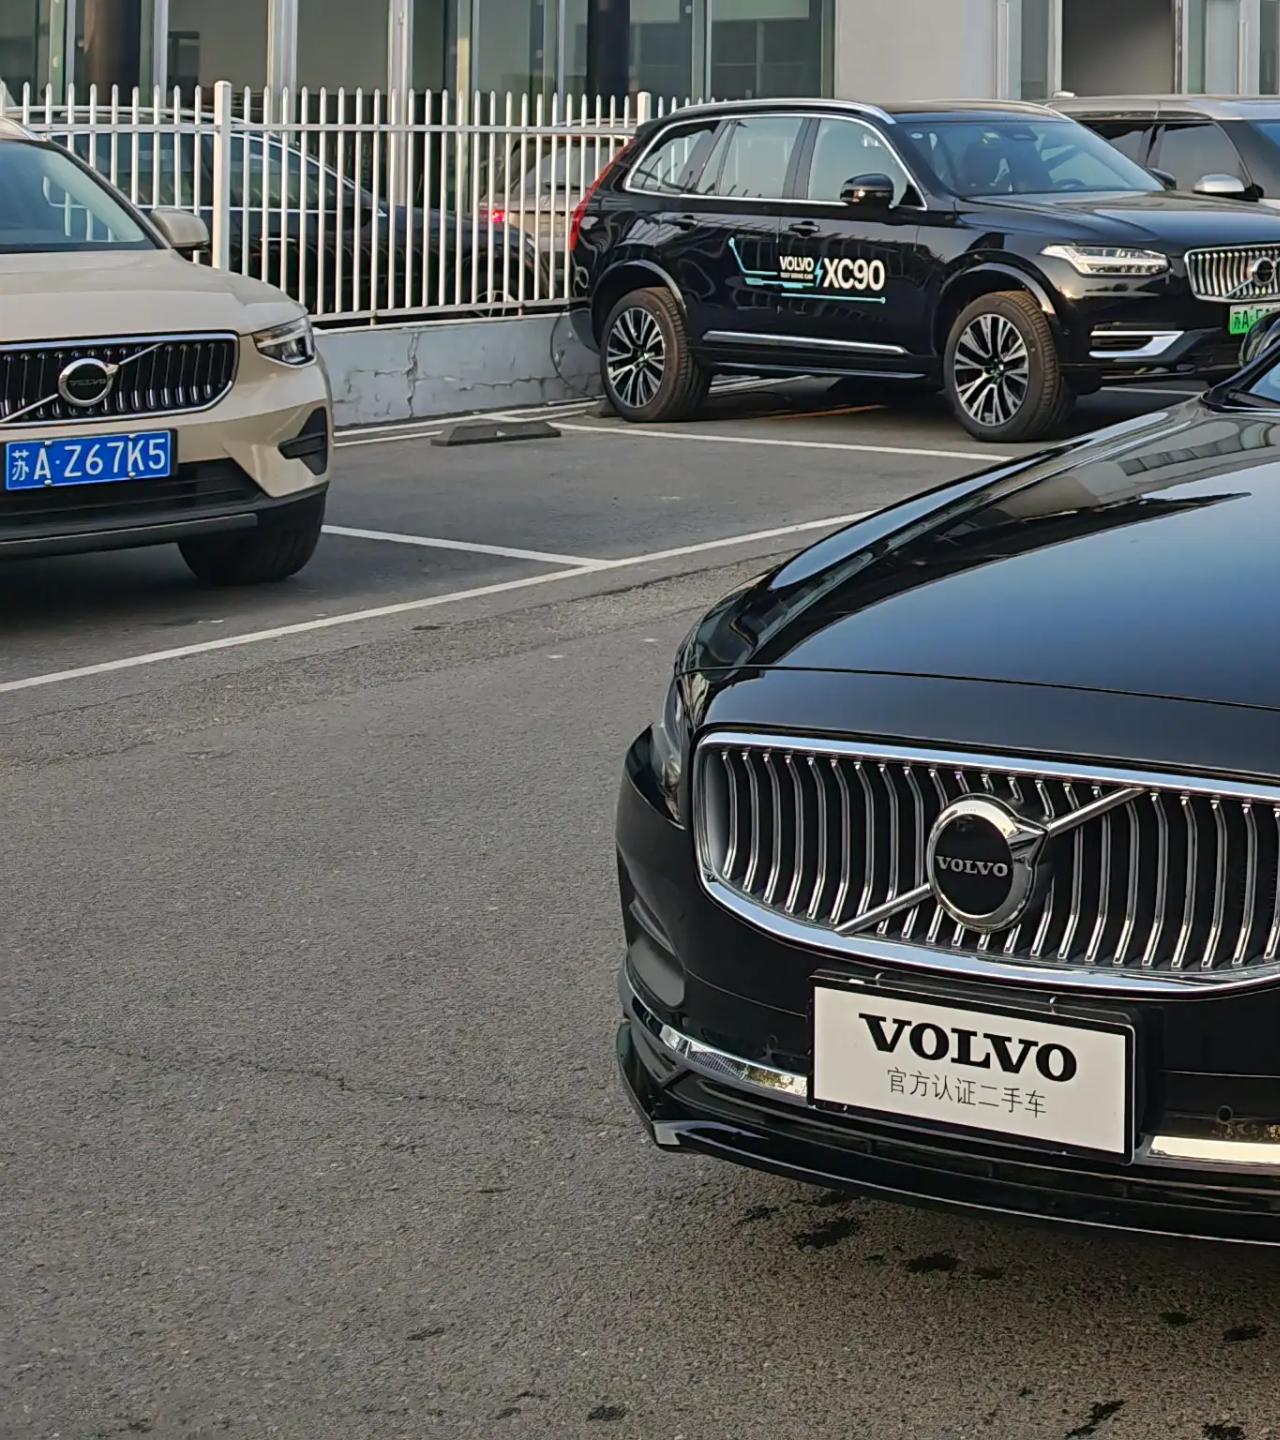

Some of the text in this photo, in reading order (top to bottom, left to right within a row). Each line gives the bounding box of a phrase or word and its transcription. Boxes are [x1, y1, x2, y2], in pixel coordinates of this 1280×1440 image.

[779, 255, 886, 291] VOLVO XC90
[935, 855, 1009, 877] VOLVO
[858, 1012, 1078, 1083] VOLVO
[887, 1066, 1047, 1119] 官方认证二手车
